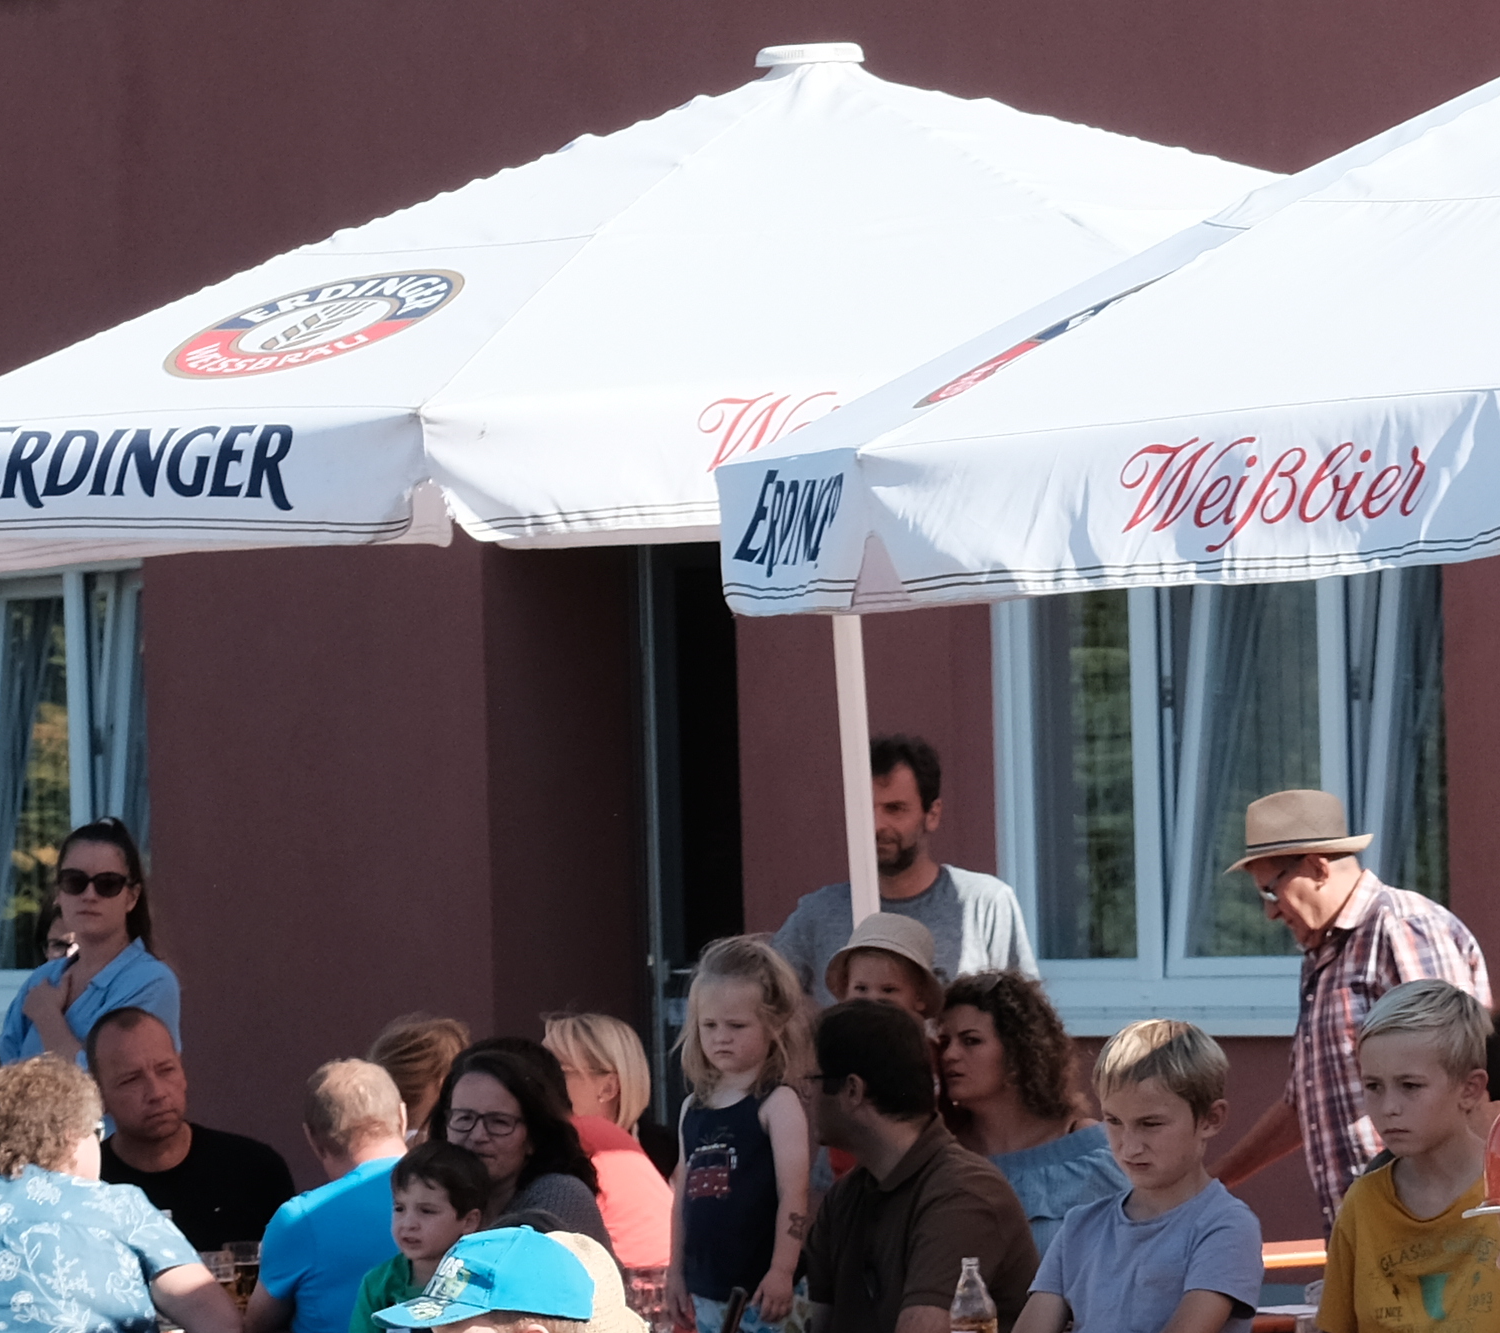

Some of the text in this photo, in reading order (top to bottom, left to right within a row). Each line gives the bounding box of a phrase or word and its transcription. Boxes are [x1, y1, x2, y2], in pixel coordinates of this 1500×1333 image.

[238, 274, 449, 323] ERDINGER
[184, 333, 369, 374] WEISSBRÄU
[1120, 436, 1430, 552] Weißbier
